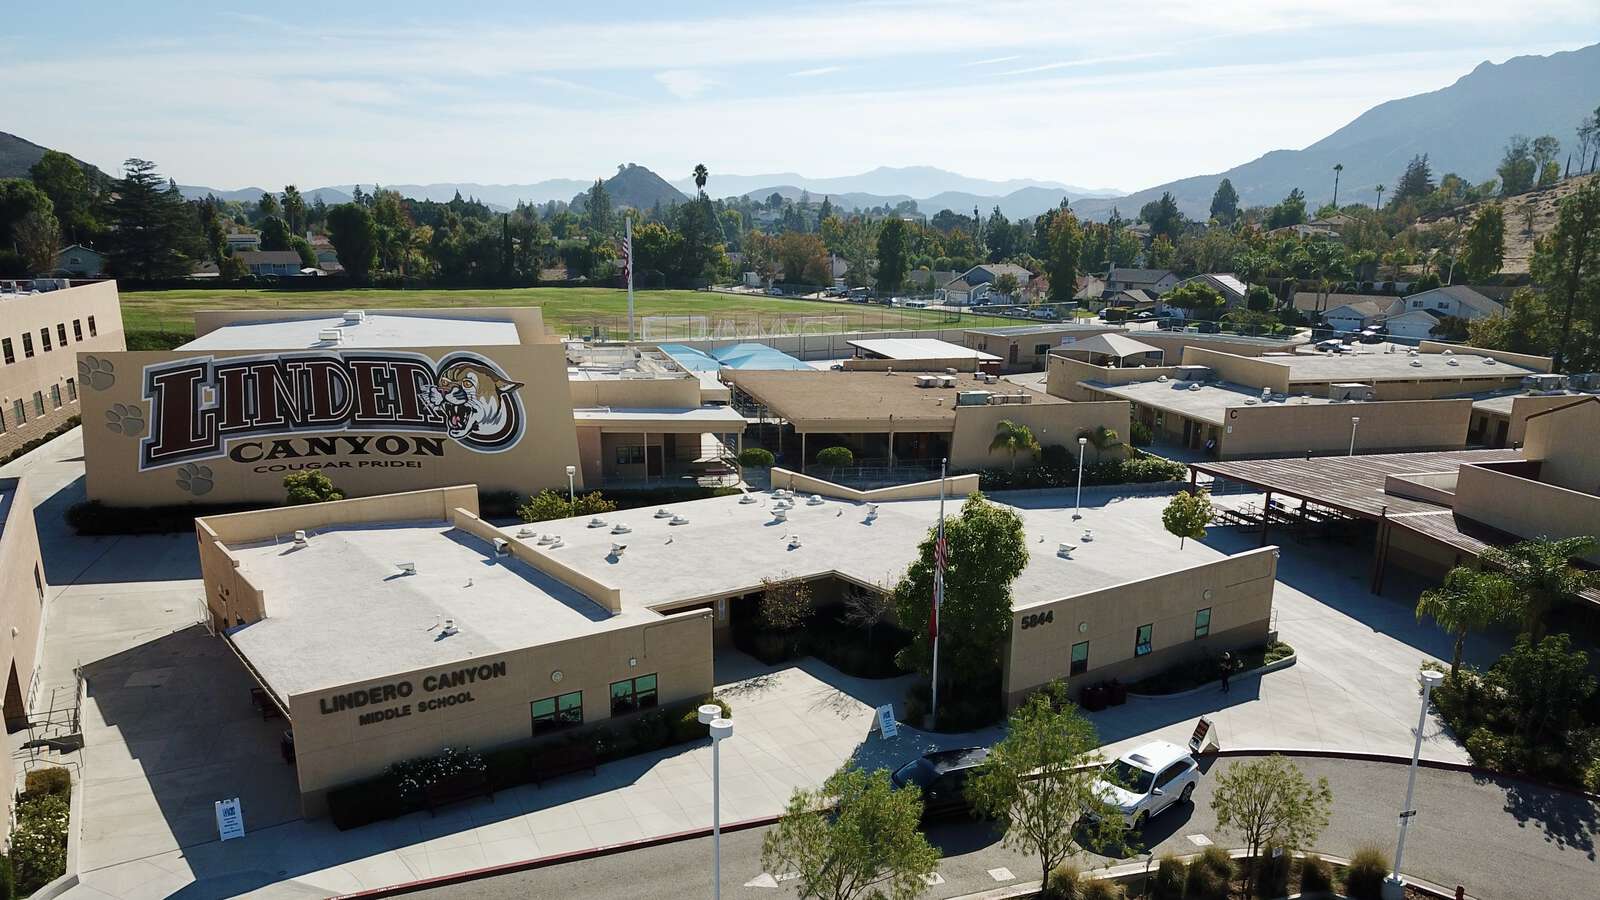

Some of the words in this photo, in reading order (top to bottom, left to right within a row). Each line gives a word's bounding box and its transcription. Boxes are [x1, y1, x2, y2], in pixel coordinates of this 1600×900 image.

[1230, 409, 1238, 419] C
[229, 435, 447, 463] CANYON
[253, 461, 352, 473] COUGAR
[358, 460, 422, 469] PRIDE!
[1021, 610, 1054, 630] 5844
[320, 681, 413, 715] LINDERO
[423, 661, 506, 692] CANYON
[358, 704, 412, 726] MIDDLE
[418, 691, 475, 713] SCHOOL
